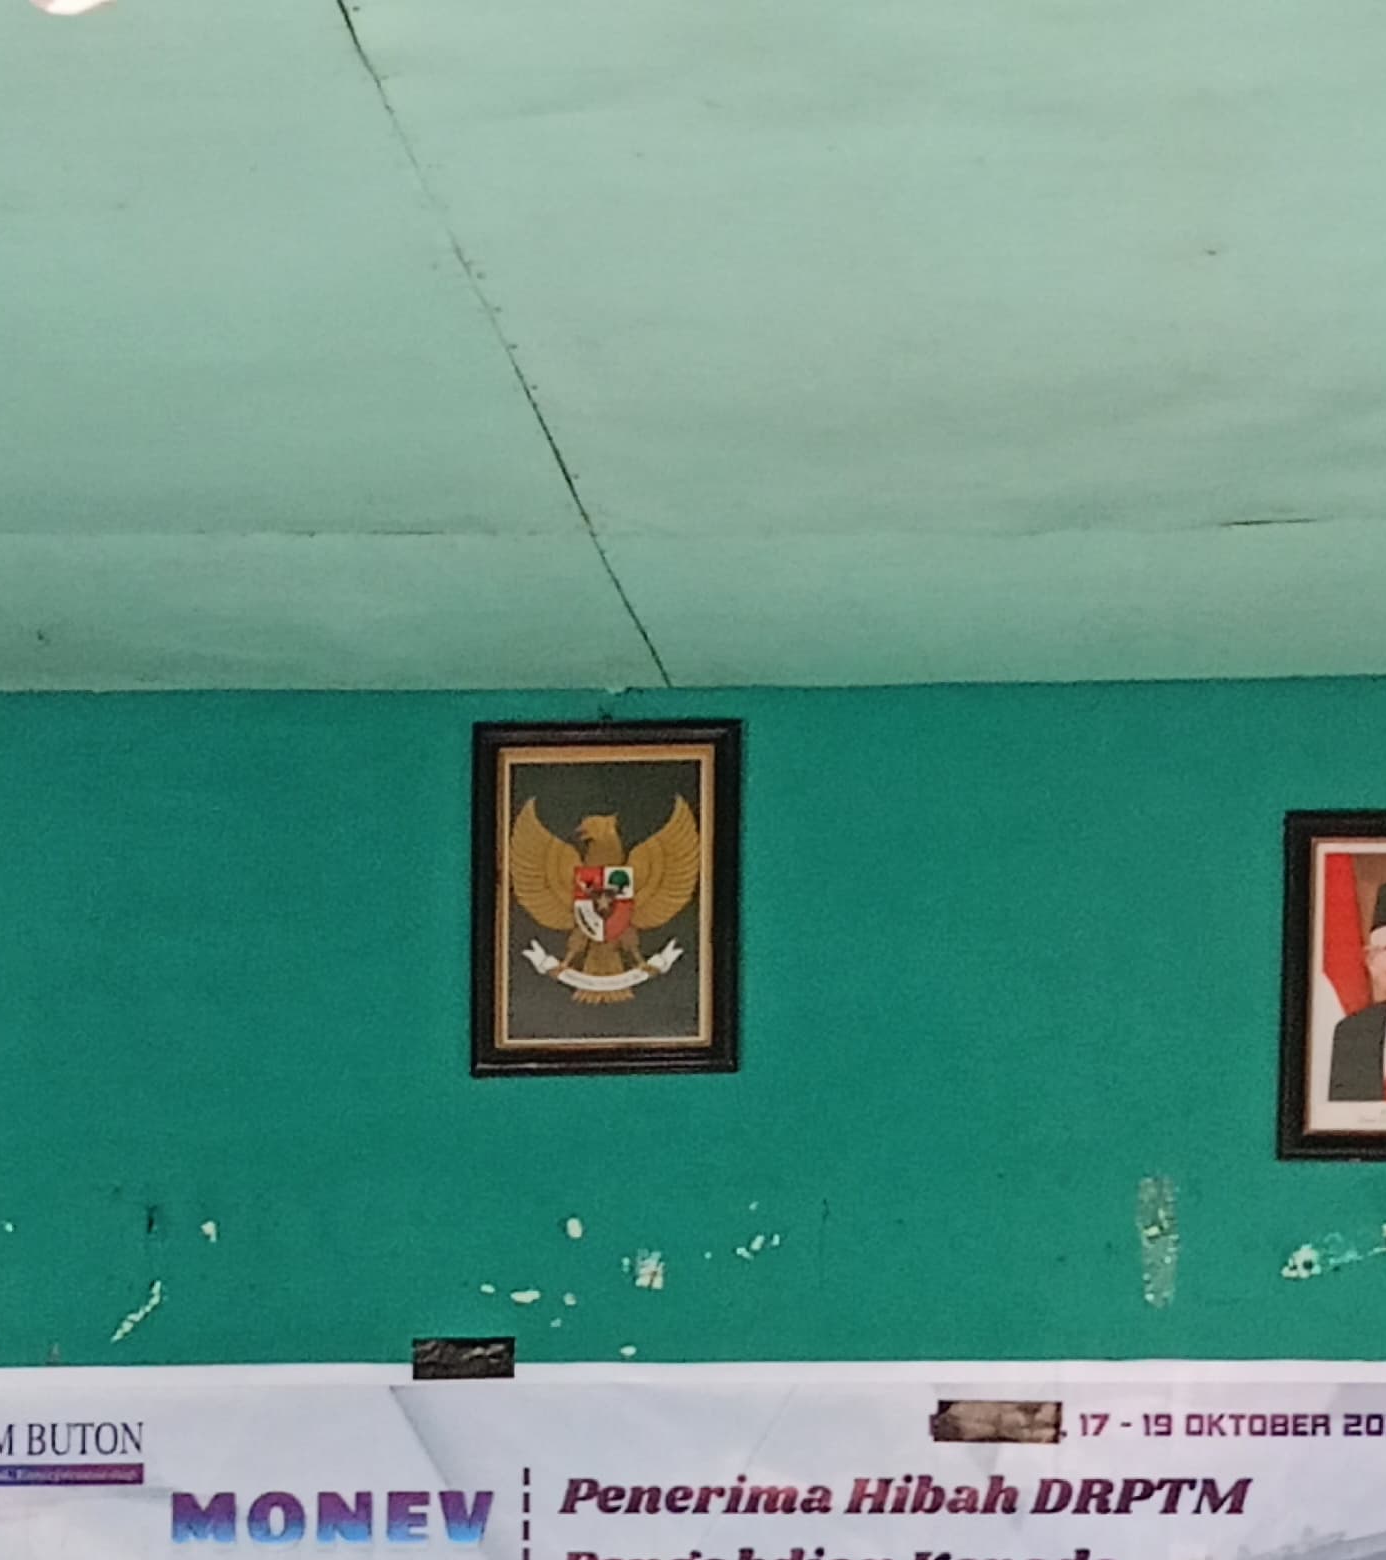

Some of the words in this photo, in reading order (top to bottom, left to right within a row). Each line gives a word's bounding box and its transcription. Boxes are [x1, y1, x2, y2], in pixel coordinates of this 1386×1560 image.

[26, 1422, 143, 1455] BUTON
[1079, 1413, 1110, 1437] 17
[1142, 1413, 1172, 1437] 19
[1185, 1413, 1331, 1437] OKTOBER
[559, 1475, 832, 1514] Penerima
[843, 1474, 1017, 1514] Hibah
[1030, 1477, 1253, 1514] DRPTM
[170, 1490, 494, 1545] MONEV
